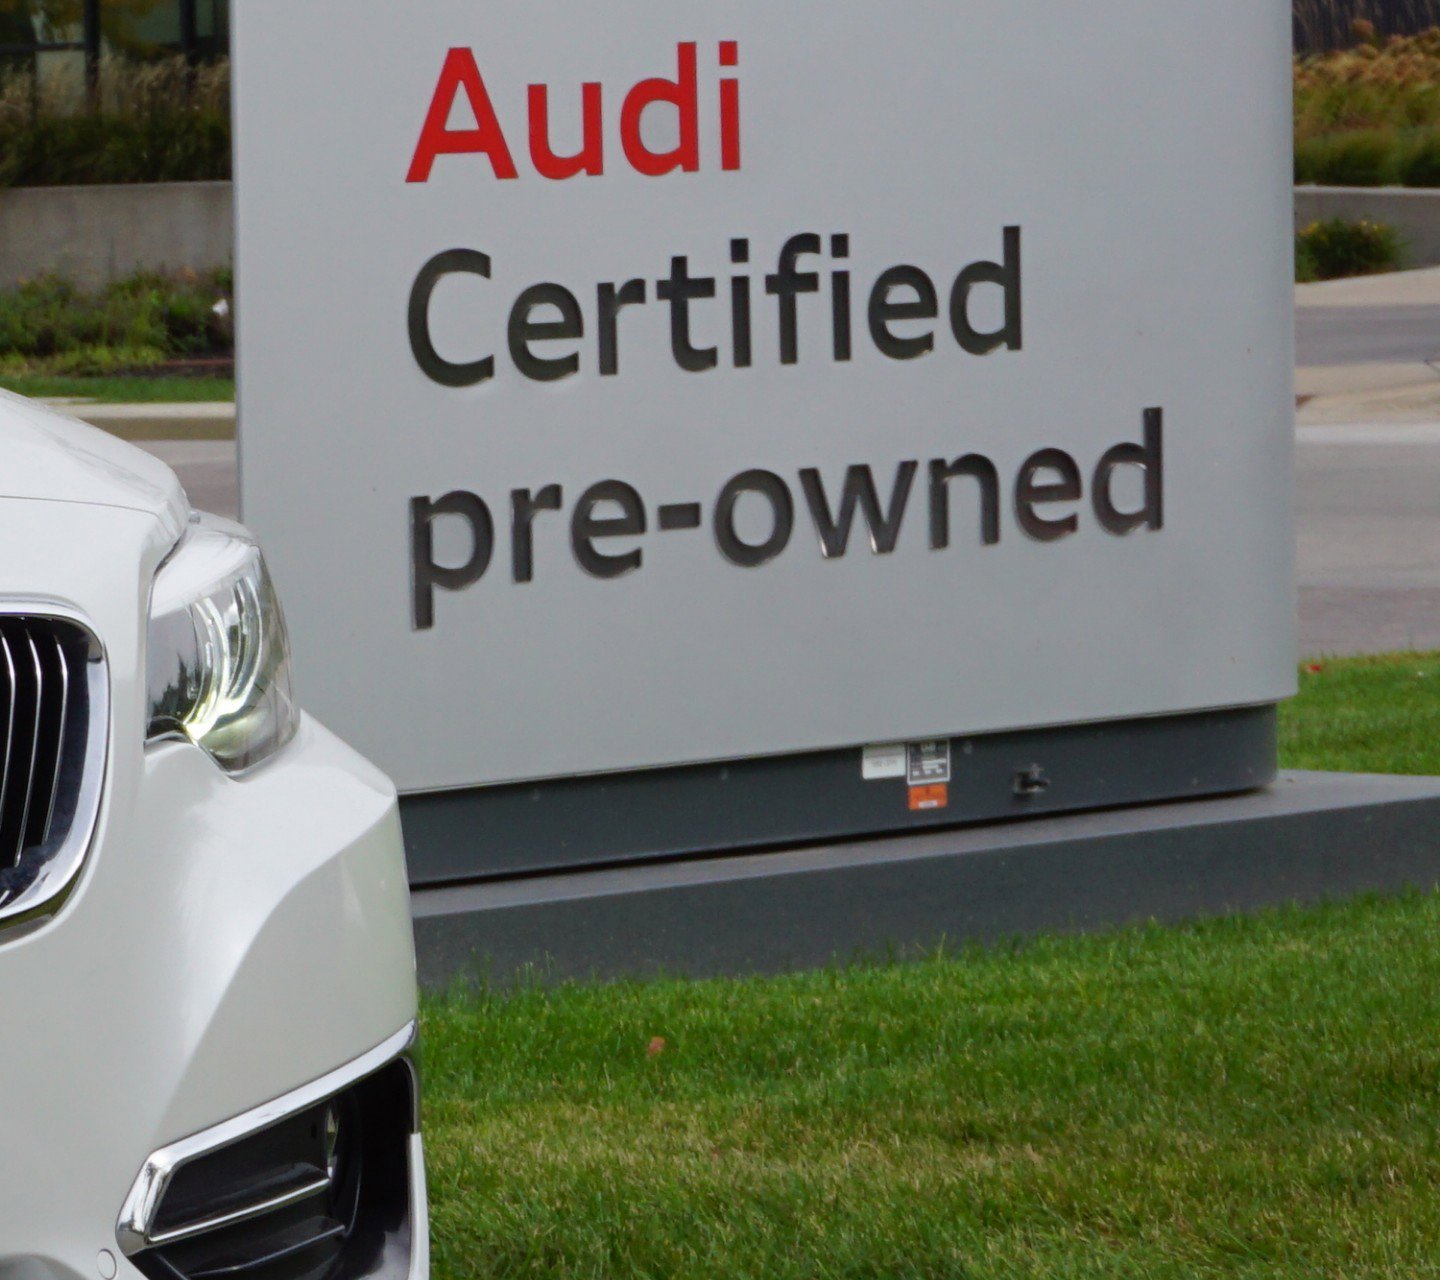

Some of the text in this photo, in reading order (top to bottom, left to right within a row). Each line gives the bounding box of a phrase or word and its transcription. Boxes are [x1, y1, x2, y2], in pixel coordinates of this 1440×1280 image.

[405, 40, 741, 183] Audi
[407, 225, 1023, 387] Certified
[409, 406, 1165, 631] pre-owned
